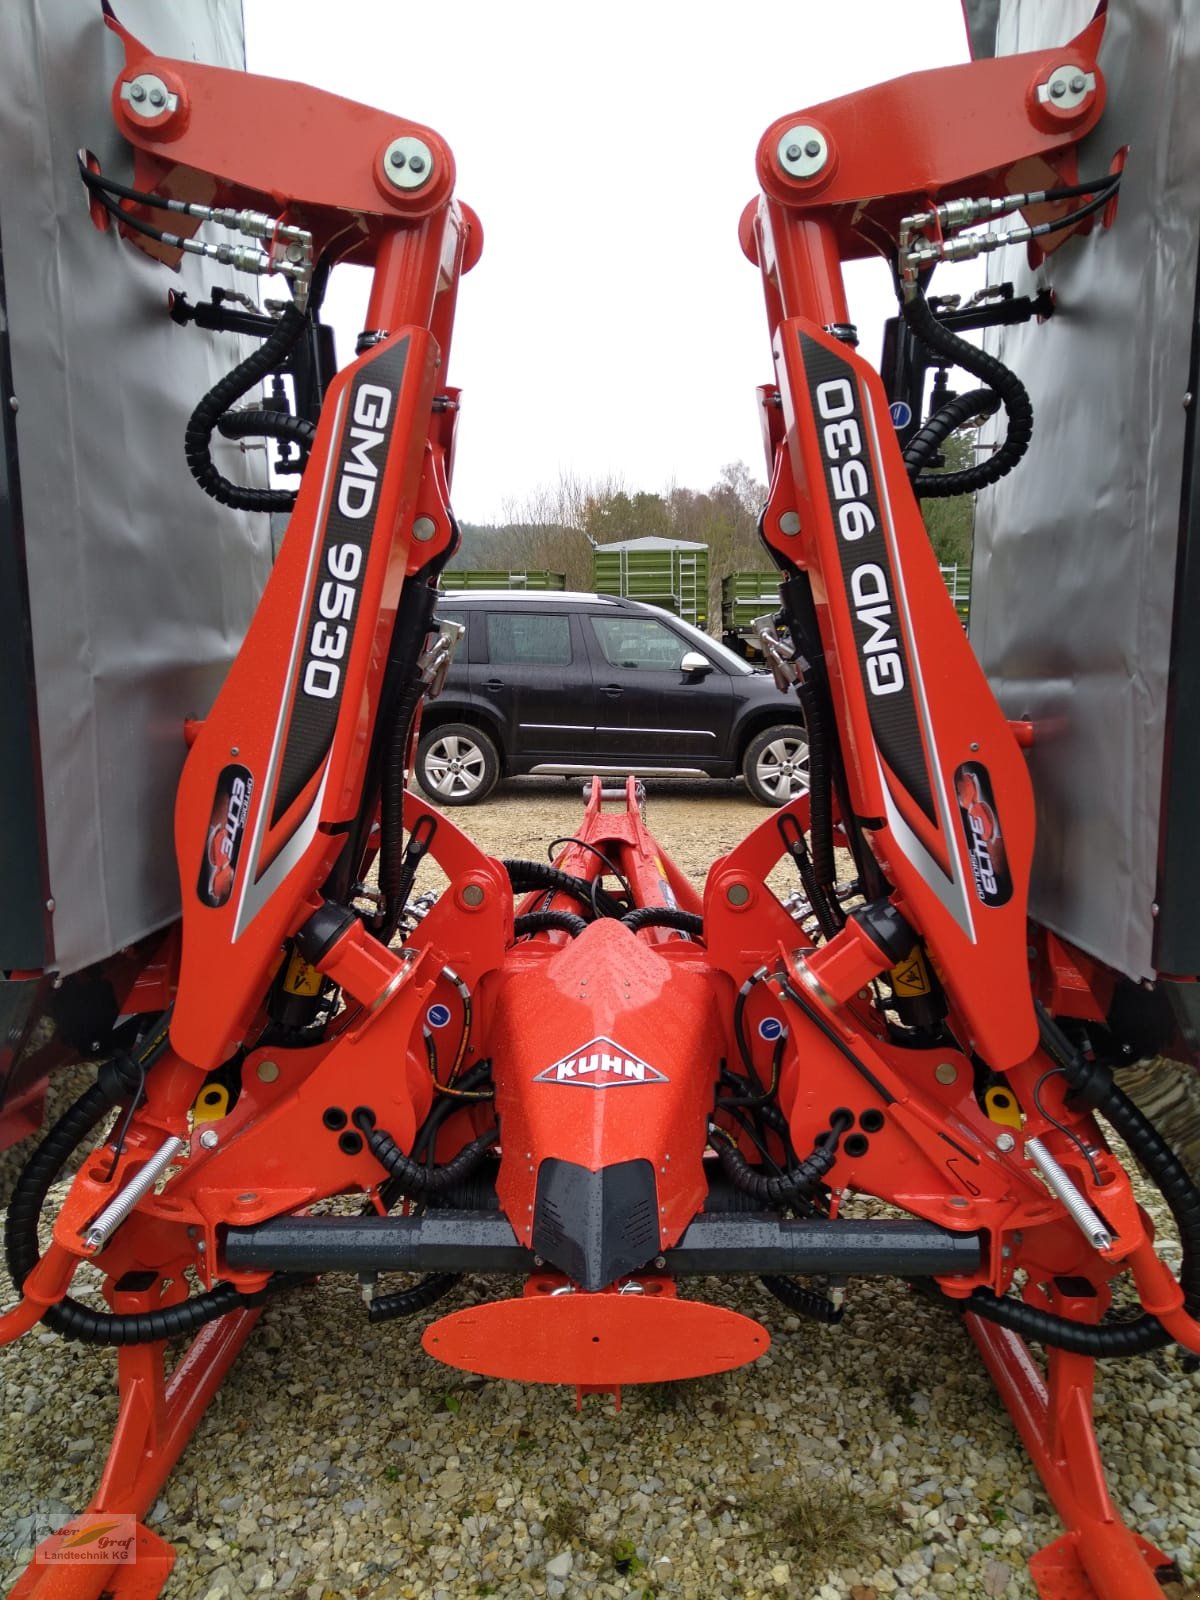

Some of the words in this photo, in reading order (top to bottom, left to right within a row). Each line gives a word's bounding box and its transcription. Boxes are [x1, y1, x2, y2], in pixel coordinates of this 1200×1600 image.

[338, 384, 392, 519] GMD
[816, 378, 876, 541] 9530
[303, 543, 363, 699] 9530
[851, 563, 905, 696] GMD
[221, 777, 245, 859] ELITE
[969, 815, 998, 895] ELITE
[556, 1053, 645, 1081] KUHN
